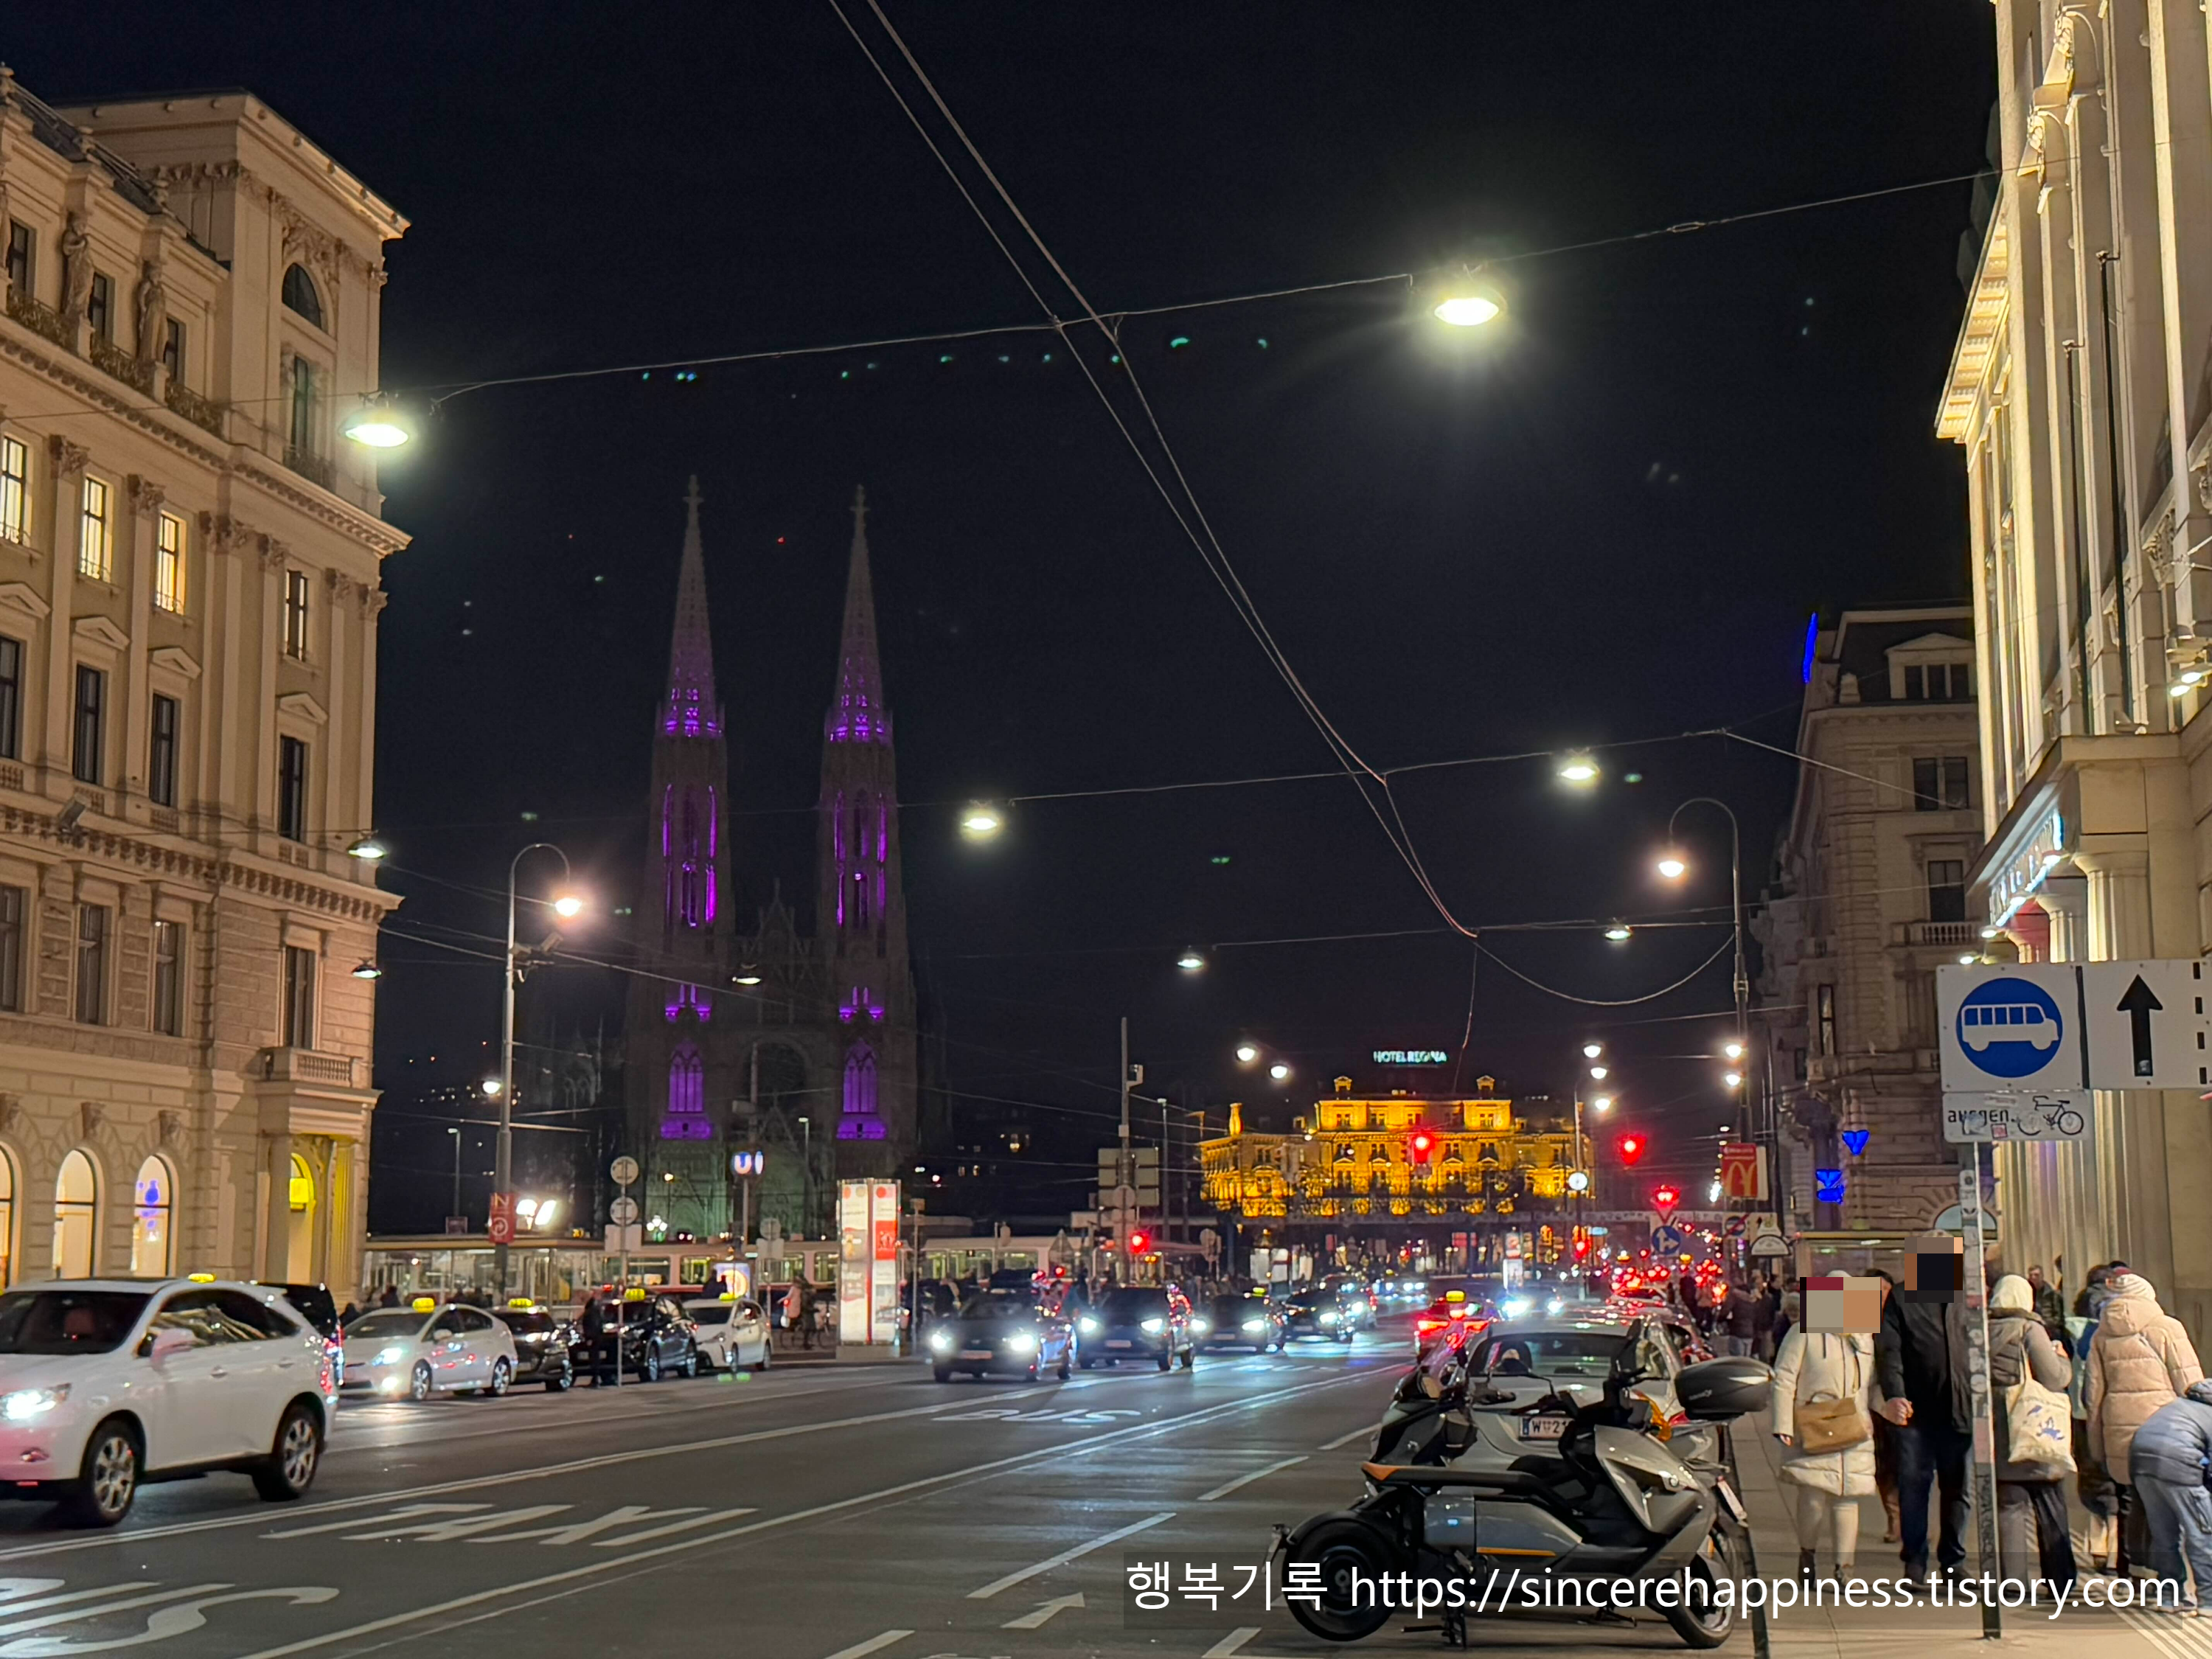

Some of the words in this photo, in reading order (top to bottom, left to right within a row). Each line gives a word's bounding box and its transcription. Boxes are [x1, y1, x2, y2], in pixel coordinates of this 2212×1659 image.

[1373, 1051, 1406, 1062] HOTEL
[931, 1408, 1141, 1423] BUS
[1532, 1420, 1541, 1433] W
[259, 1503, 759, 1546] TAXI
